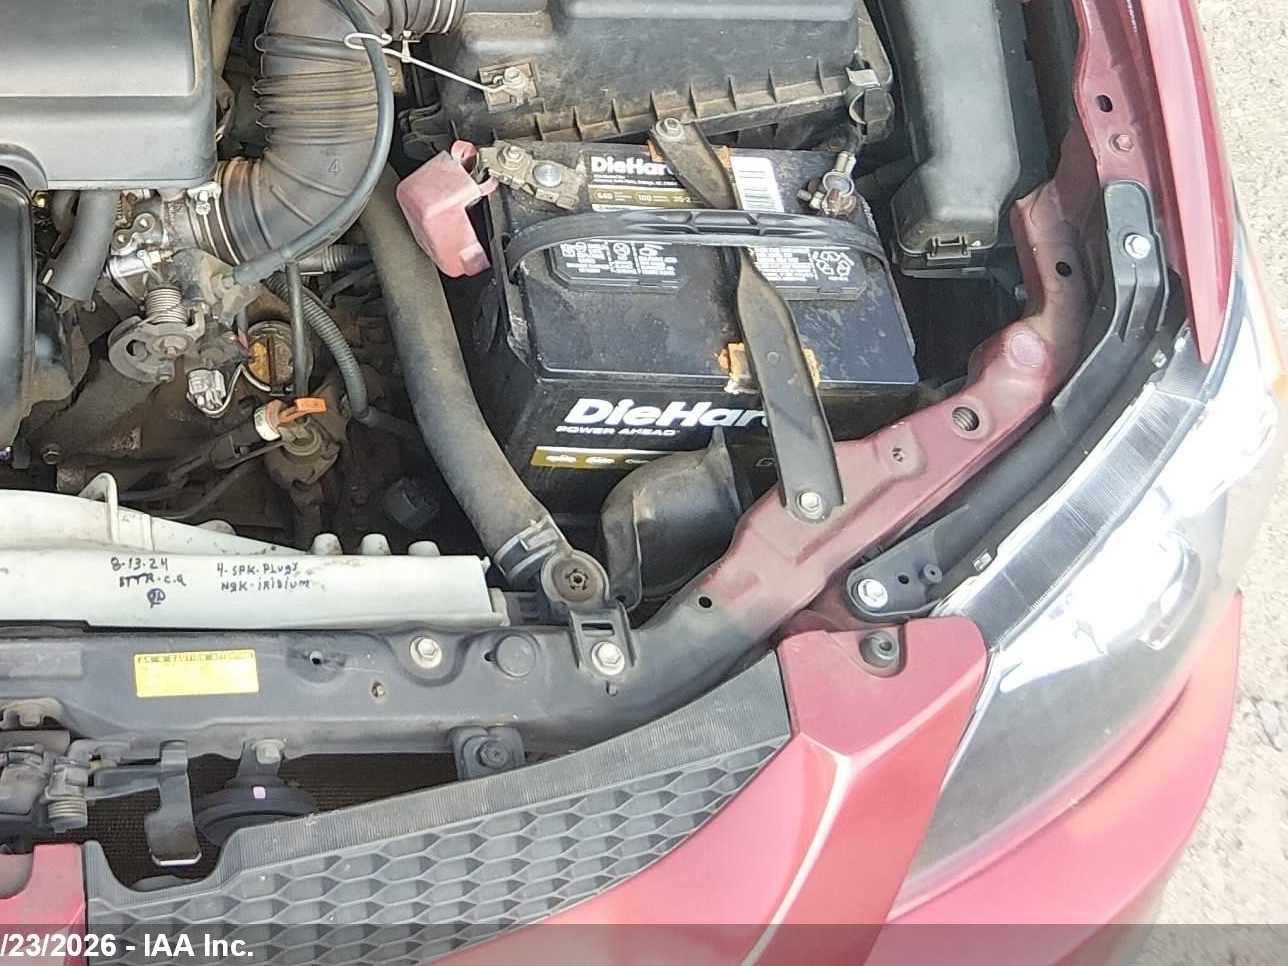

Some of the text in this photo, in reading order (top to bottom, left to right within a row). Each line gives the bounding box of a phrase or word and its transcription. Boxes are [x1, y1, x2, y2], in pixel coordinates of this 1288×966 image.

[564, 398, 767, 428] DieHar
[556, 425, 677, 436] POWER AHEAD
